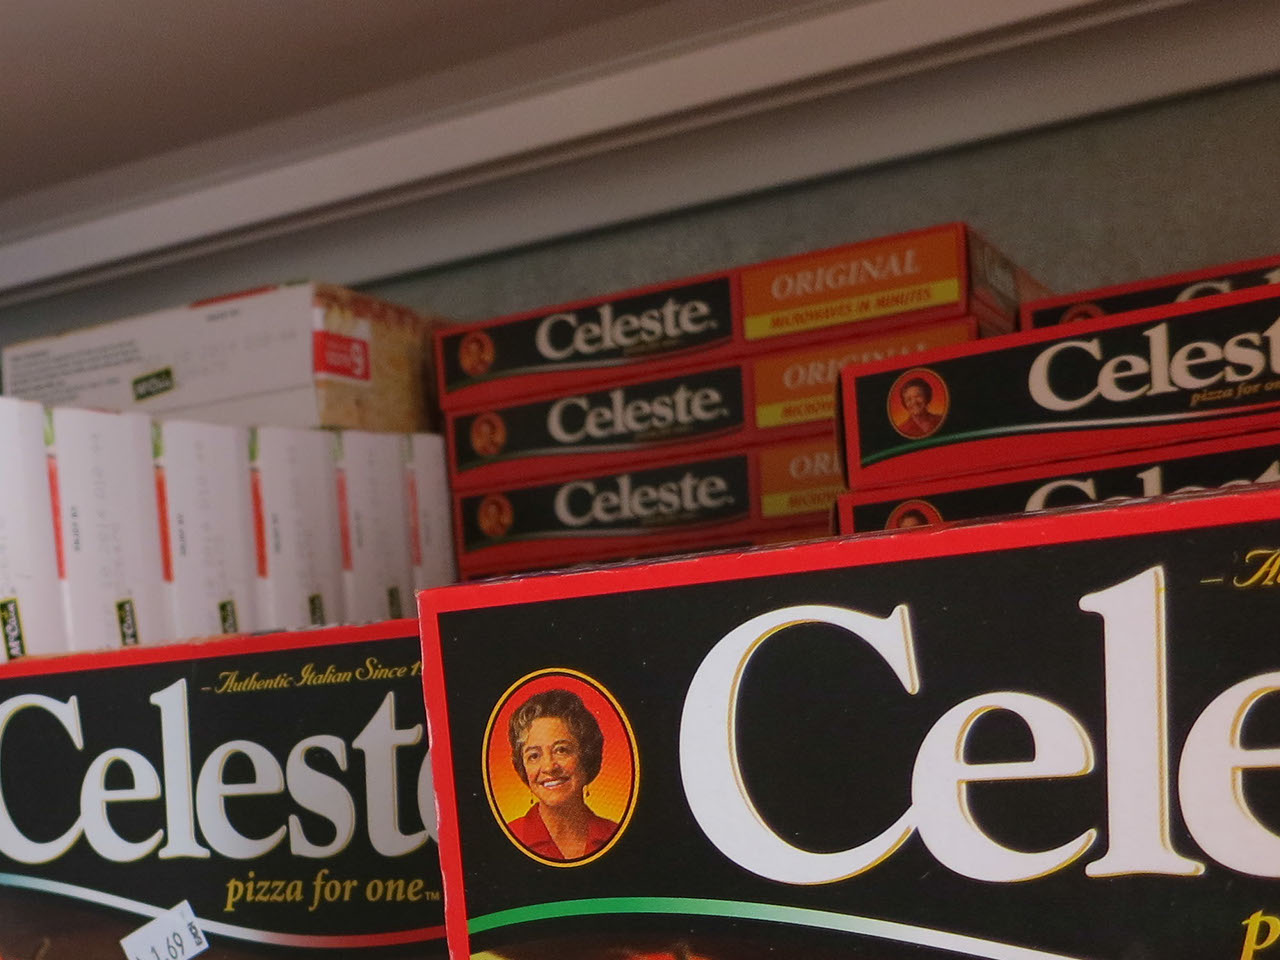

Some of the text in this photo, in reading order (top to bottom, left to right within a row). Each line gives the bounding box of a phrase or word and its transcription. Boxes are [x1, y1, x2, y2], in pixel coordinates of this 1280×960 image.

[771, 250, 920, 300] ORIGINAL
[535, 297, 713, 361] Celeste
[548, 384, 725, 444] Celeste
[555, 472, 730, 527] Celeste
[215, 670, 294, 694] Authentic
[296, 663, 352, 687] Italian
[355, 657, 407, 681] Since
[223, 870, 304, 912] pizza
[308, 868, 358, 912] for
